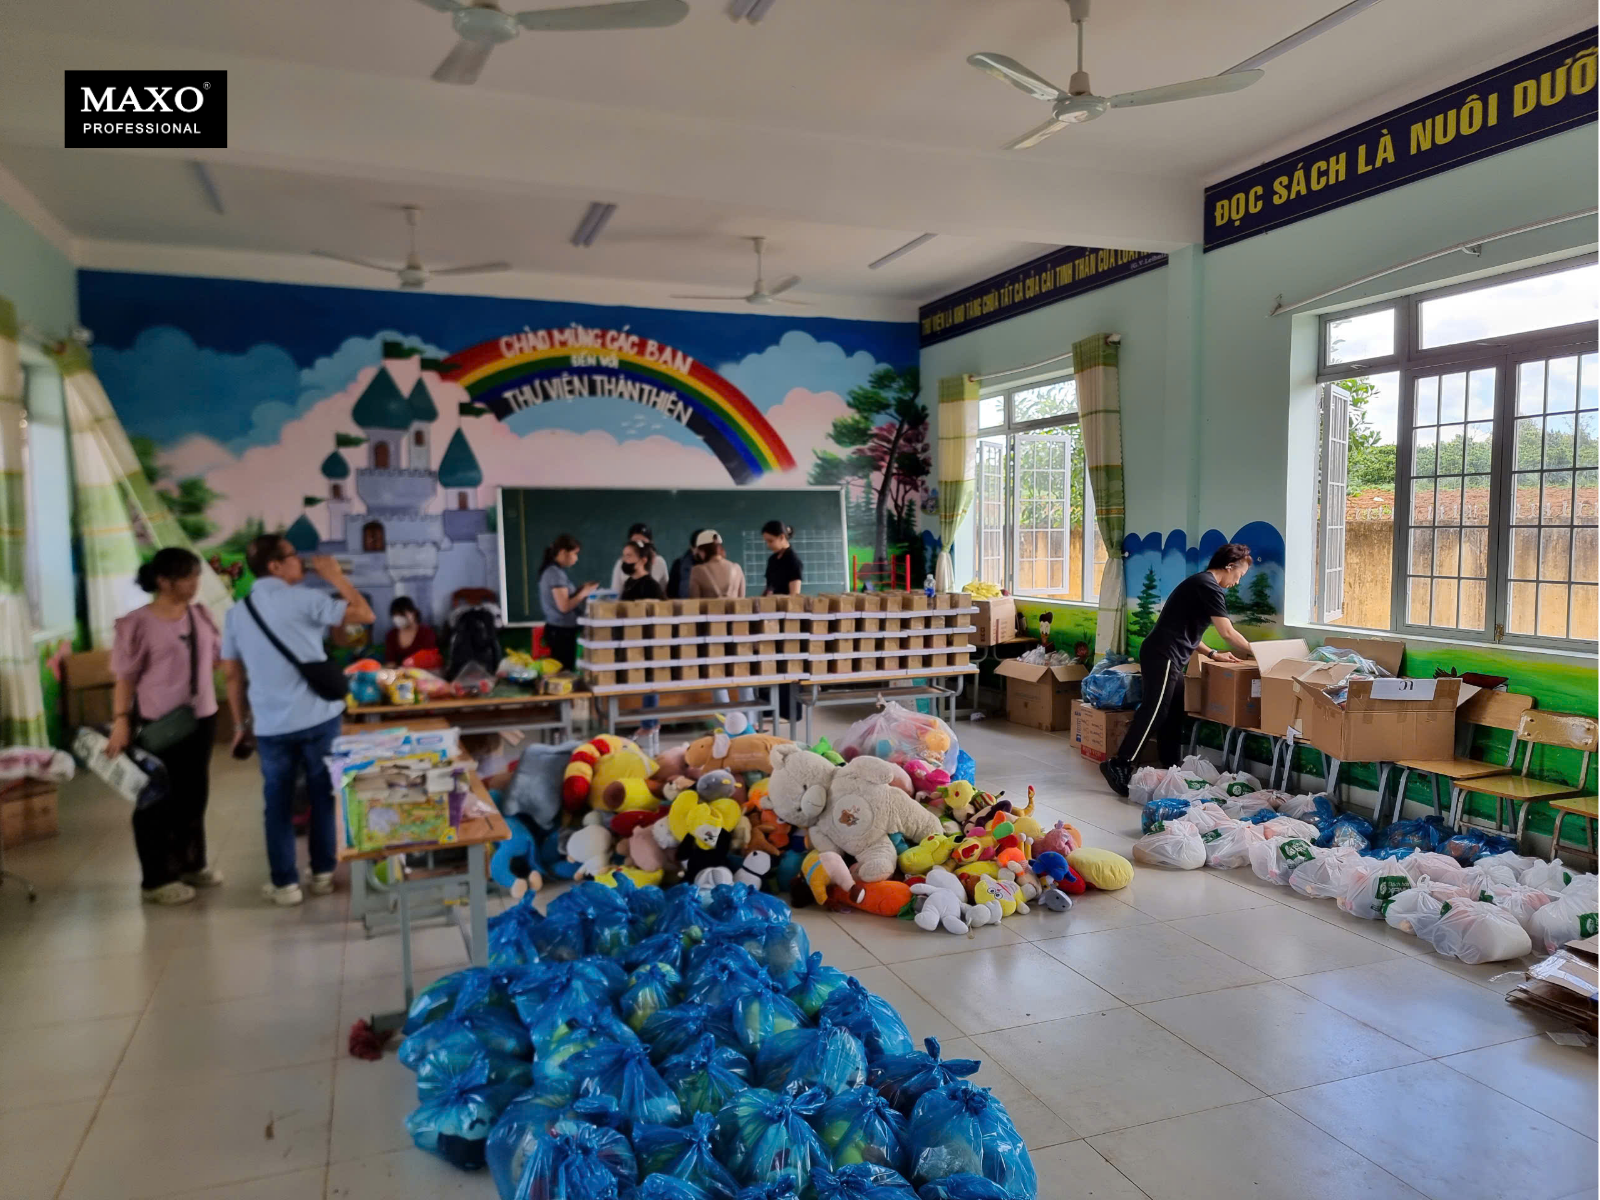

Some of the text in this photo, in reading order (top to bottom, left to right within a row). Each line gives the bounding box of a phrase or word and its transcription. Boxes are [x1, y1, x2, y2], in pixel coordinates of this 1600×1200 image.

[1214, 186, 1264, 227] ĐỌC
[1273, 152, 1347, 205] SÁCH
[1357, 128, 1396, 175] LÀ
[1410, 92, 1498, 156] NUÔI
[499, 325, 551, 359] CHÀO
[606, 324, 640, 355] CÁC
[544, 371, 590, 403] VIỆN
